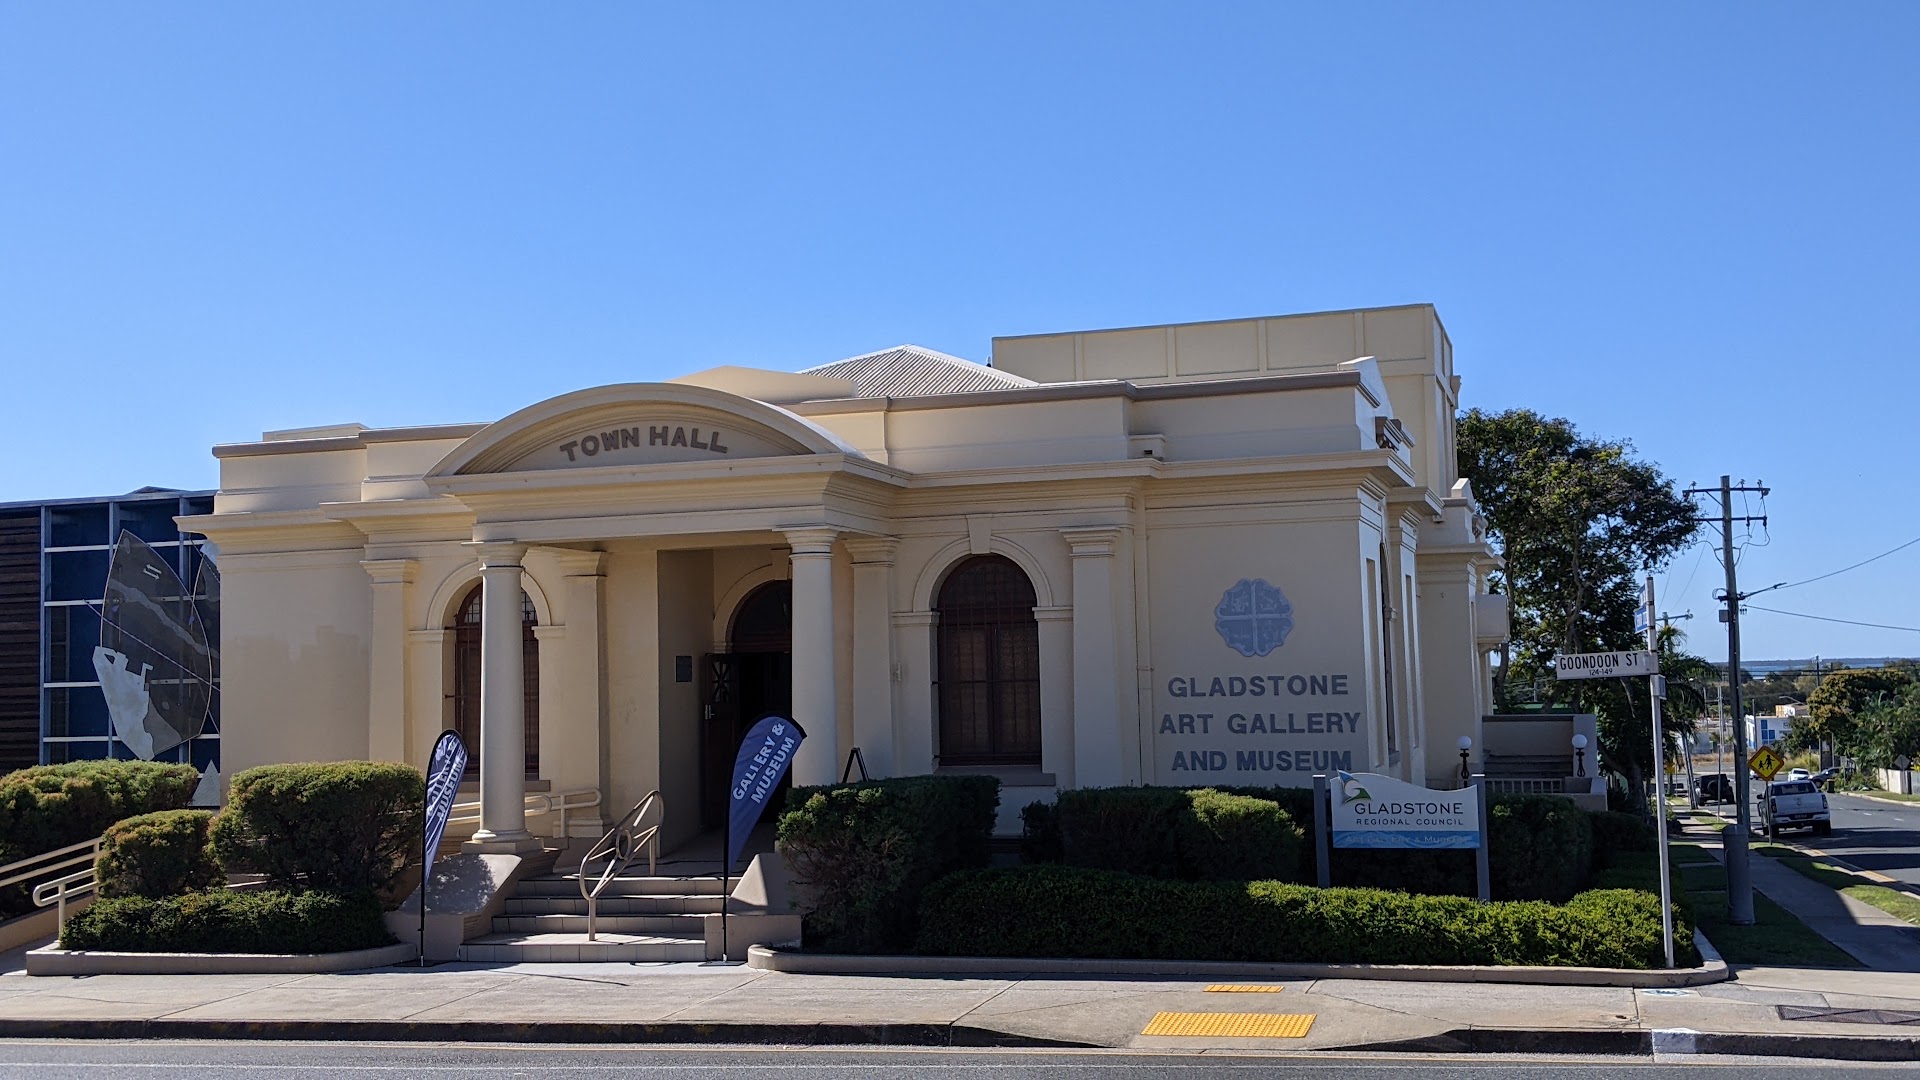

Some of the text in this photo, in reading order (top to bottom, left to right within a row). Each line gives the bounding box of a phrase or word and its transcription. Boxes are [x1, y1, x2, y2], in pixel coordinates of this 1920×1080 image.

[559, 425, 728, 462] TOWN HALL
[1560, 653, 1638, 670] GOONDOON ST
[1589, 668, 1613, 676] 124-149
[1168, 674, 1349, 697] GLADSTONE
[1159, 712, 1361, 734] ART GALLERY
[732, 723, 786, 800] GALLERY &
[750, 736, 795, 804] MUSEUM
[1171, 750, 1352, 772] AND MUSEUM
[437, 754, 464, 820] MUSEUM
[1354, 802, 1464, 815] GLADSTONE
[1356, 818, 1464, 826] REGIONAL COUNCIL
